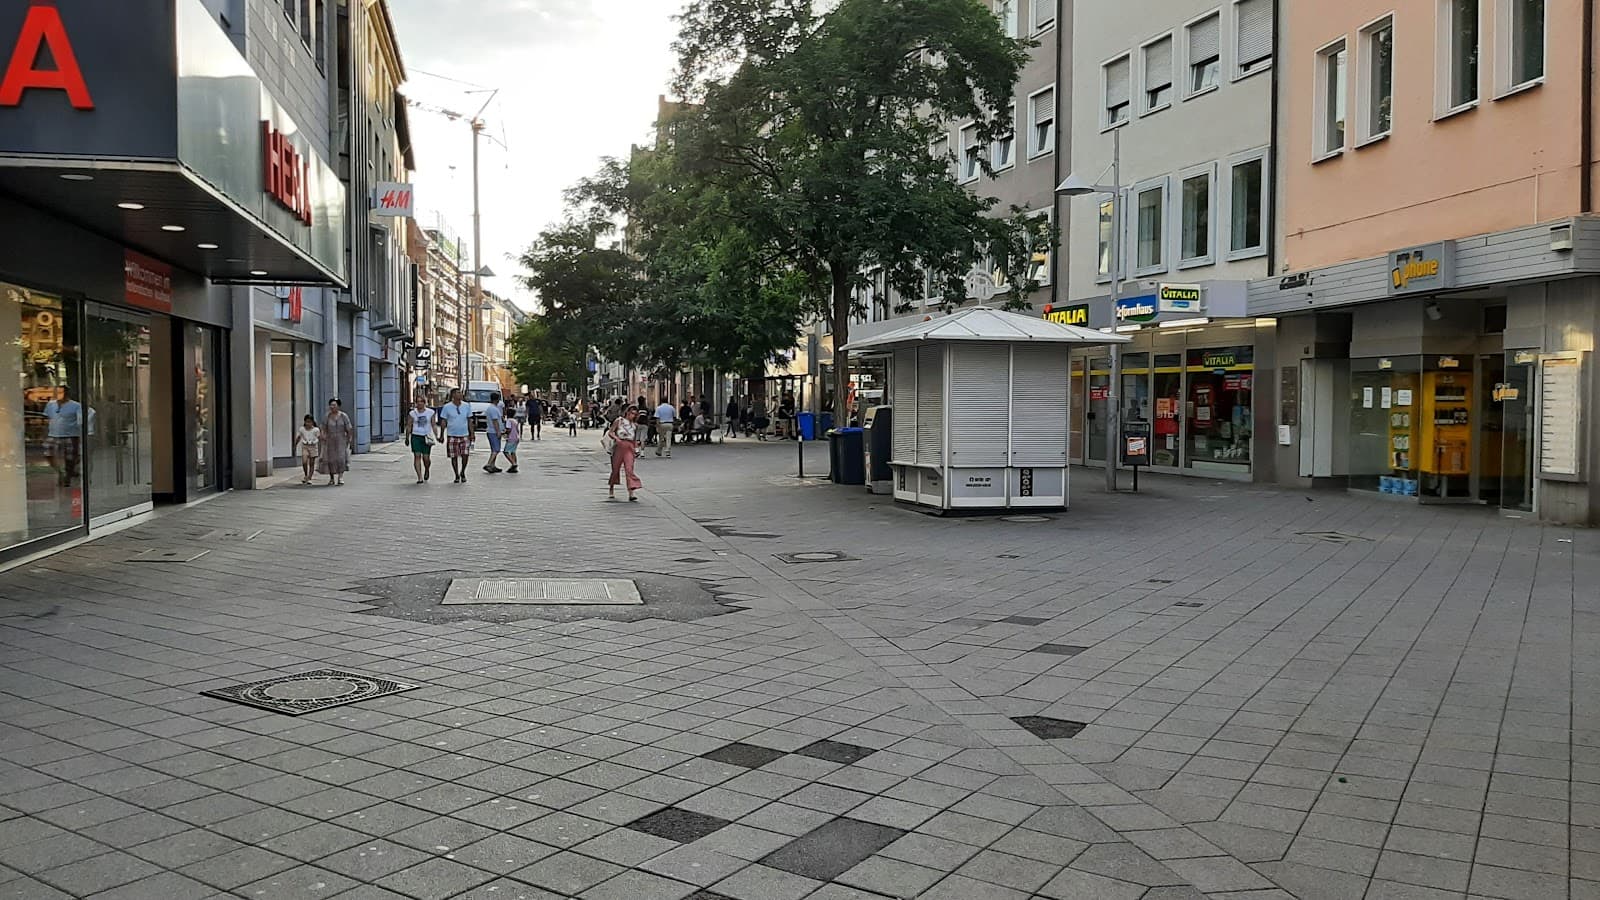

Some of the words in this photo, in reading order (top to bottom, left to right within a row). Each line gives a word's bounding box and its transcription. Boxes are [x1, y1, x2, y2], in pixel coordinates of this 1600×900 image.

[0, 4, 95, 110] A
[381, 190, 410, 209] H&M
[1163, 289, 1198, 299] VITALIA
[417, 349, 431, 358] JD
[1204, 355, 1235, 366] VITALIA
